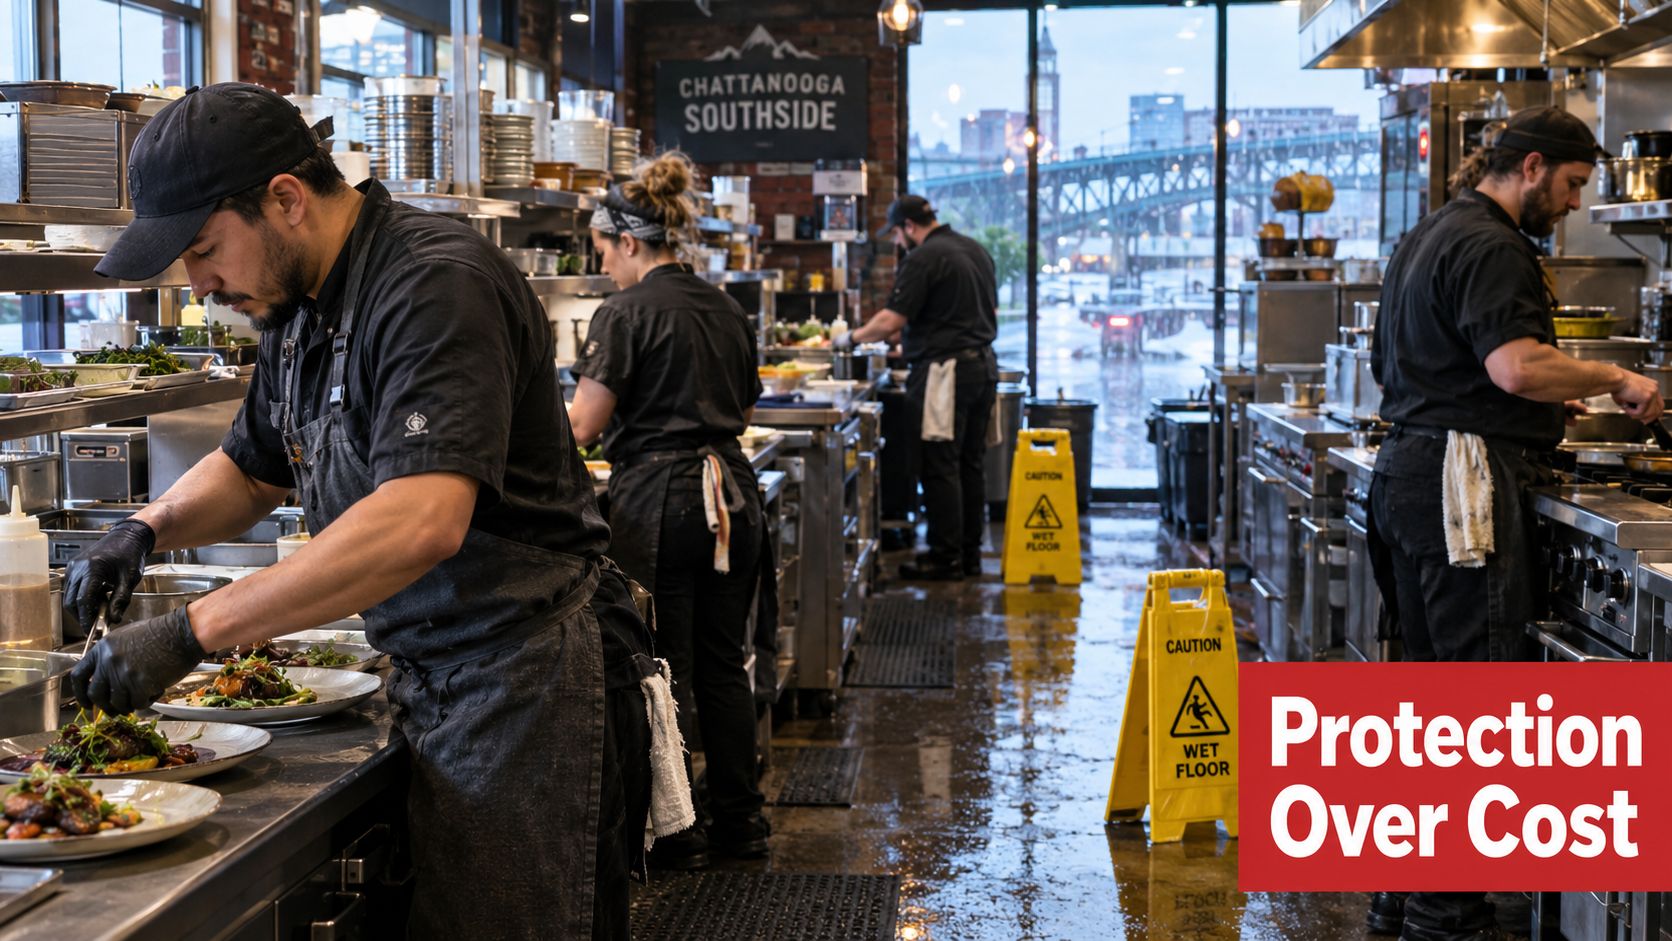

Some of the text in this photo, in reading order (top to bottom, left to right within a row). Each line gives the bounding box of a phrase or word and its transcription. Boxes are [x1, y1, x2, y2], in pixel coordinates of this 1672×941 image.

[679, 73, 845, 97] CHATTANOOGA
[684, 99, 837, 133] SOUTHSIDE
[1025, 471, 1063, 481] CAUTION
[1032, 531, 1055, 541] WET
[1026, 542, 1061, 552] FLOOR
[1165, 637, 1222, 655] CAUTION
[1182, 742, 1220, 759] WET
[1175, 760, 1231, 779] FLOOR
